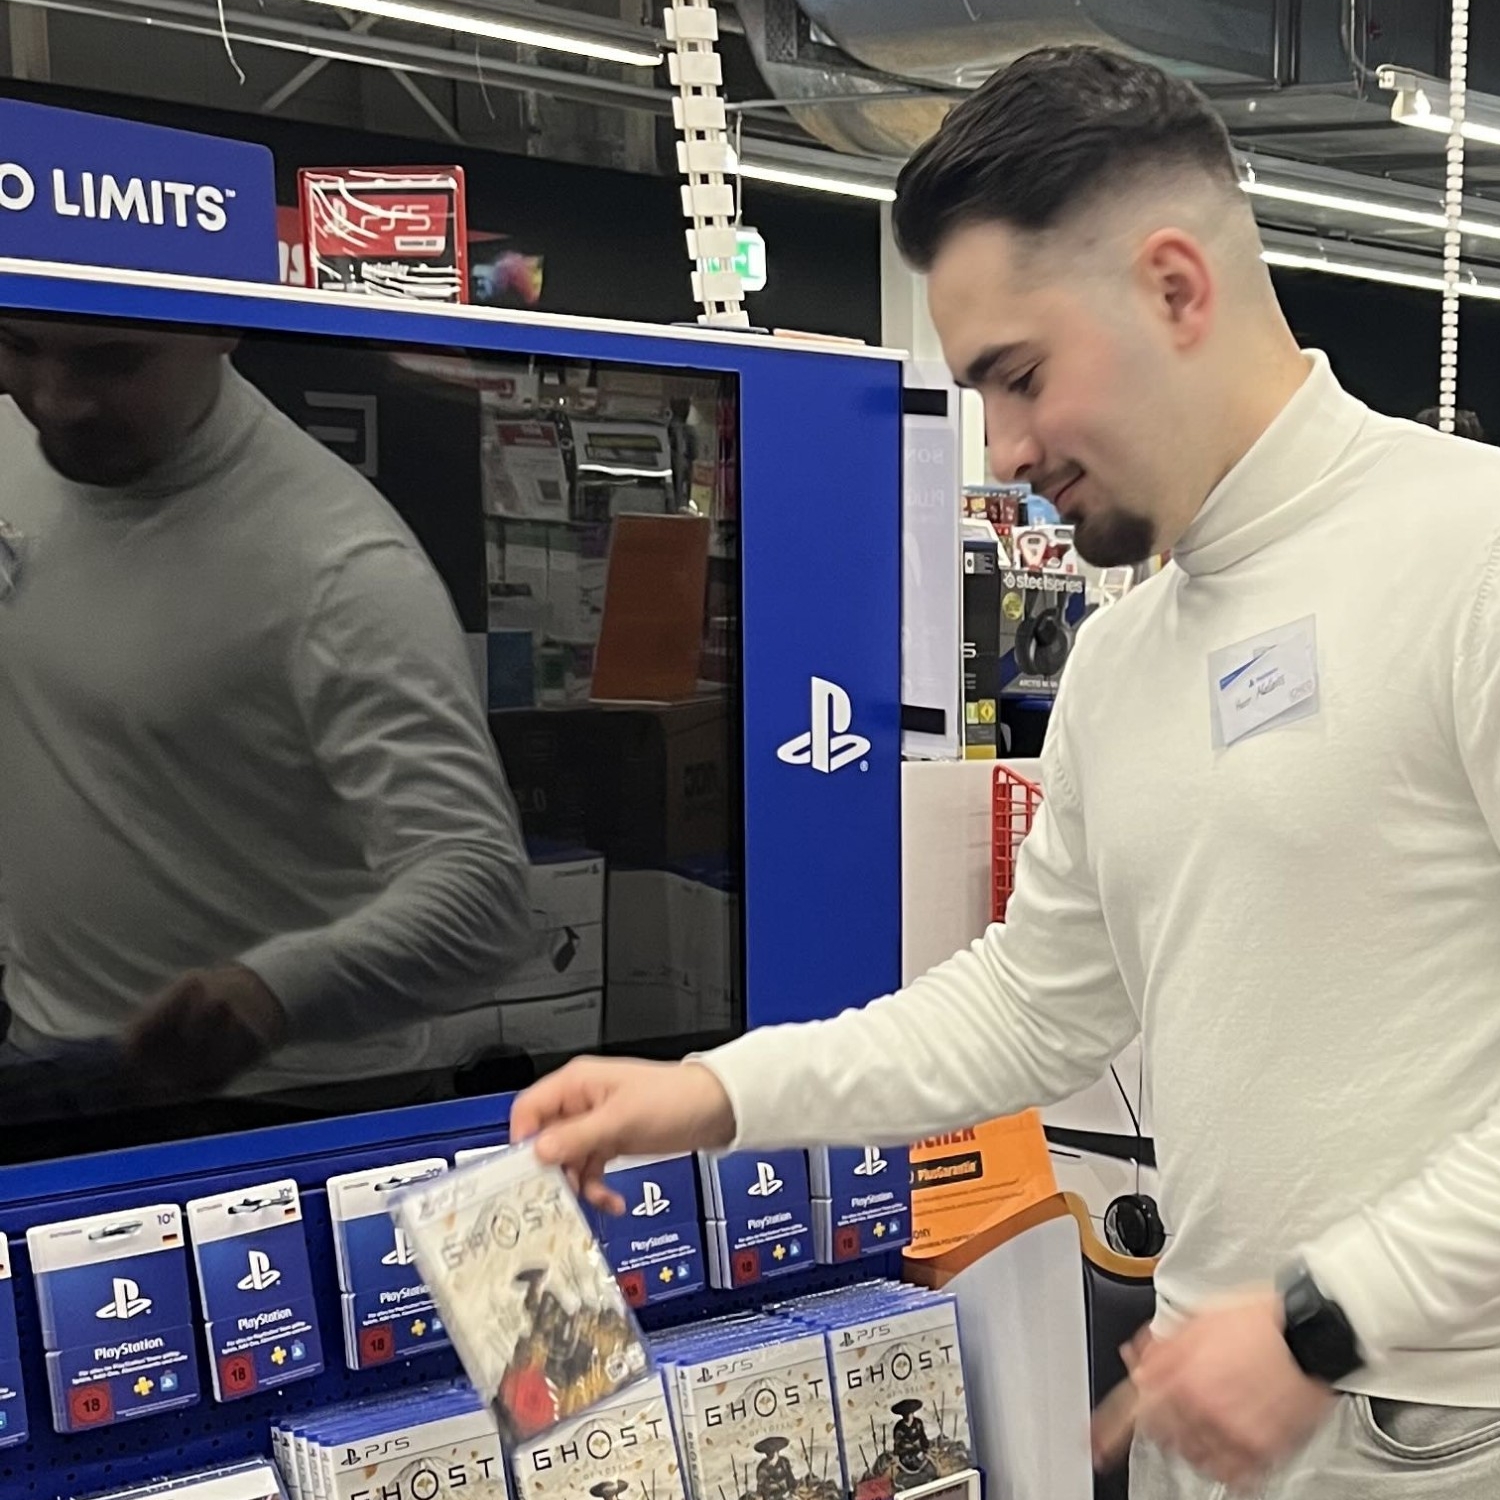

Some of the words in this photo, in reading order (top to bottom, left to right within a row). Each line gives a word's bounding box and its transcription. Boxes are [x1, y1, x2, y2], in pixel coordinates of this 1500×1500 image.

[1017, 573, 1084, 594] steelseries
[237, 1308, 293, 1331] PlayStation
[857, 1324, 891, 1341] PS5
[93, 1337, 165, 1361] PlayStation
[231, 1367, 247, 1382] 18
[717, 1360, 754, 1376] PS5
[846, 1345, 954, 1390] GHOST
[82, 1398, 101, 1413] 18
[704, 1379, 824, 1428] GHOST
[364, 1436, 411, 1458] PS5
[531, 1418, 663, 1473] GHOST
